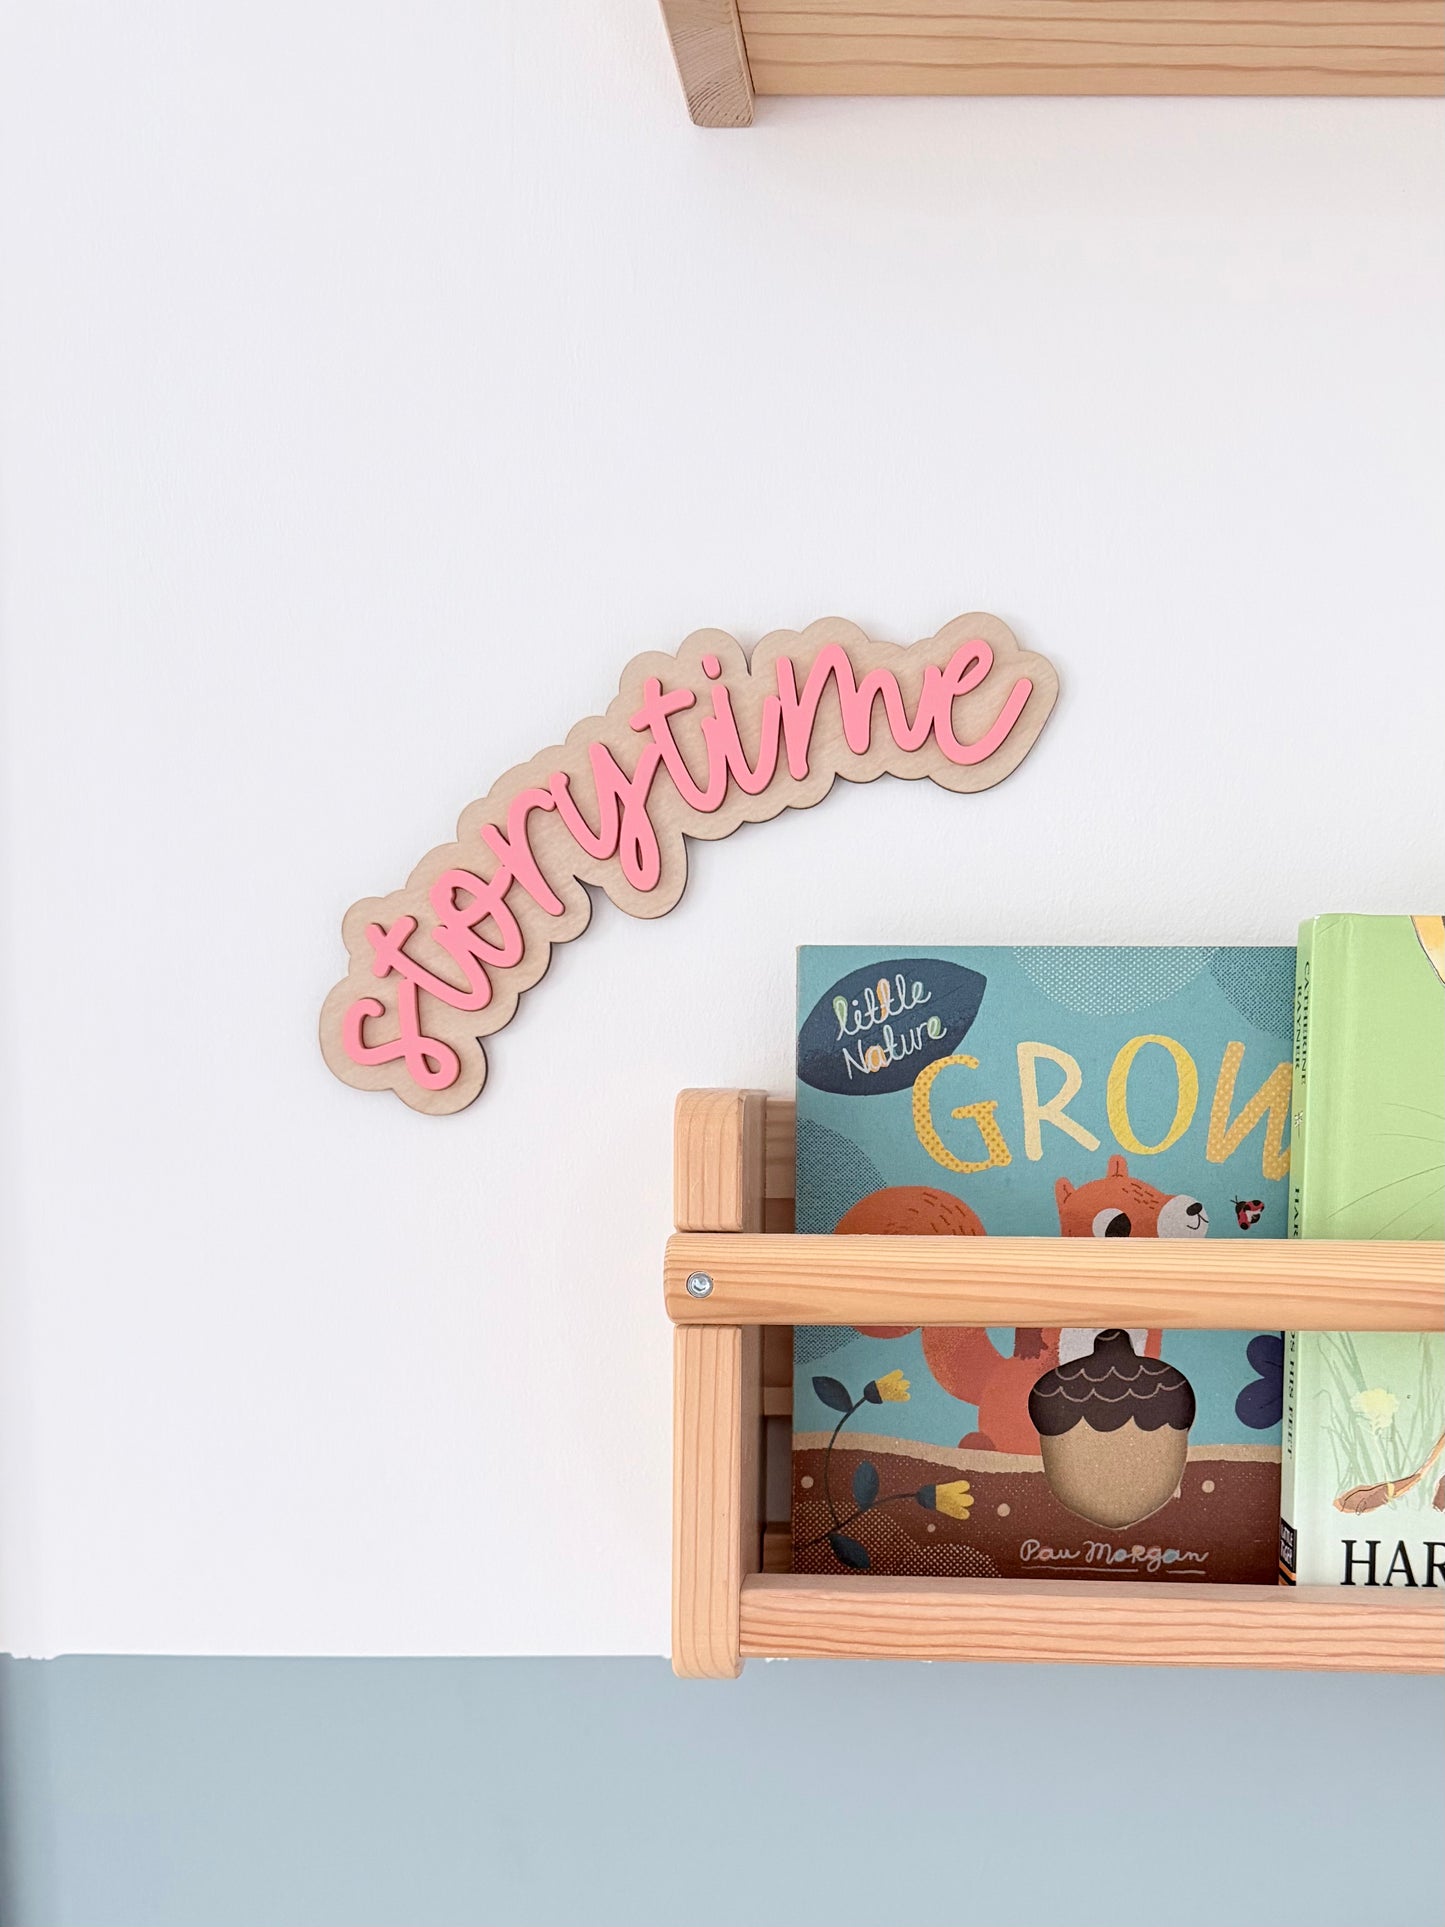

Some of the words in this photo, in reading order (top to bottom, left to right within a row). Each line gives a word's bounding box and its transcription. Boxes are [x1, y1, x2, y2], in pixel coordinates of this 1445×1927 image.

[342, 638, 1033, 1091] storytime
[833, 974, 931, 1041] little
[1301, 961, 1310, 1086] CATHERINE
[843, 1016, 947, 1080] Nature
[912, 1034, 1293, 1181] GROW
[1020, 1539, 1081, 1562] Pau
[1340, 1540, 1445, 1587] HAR
